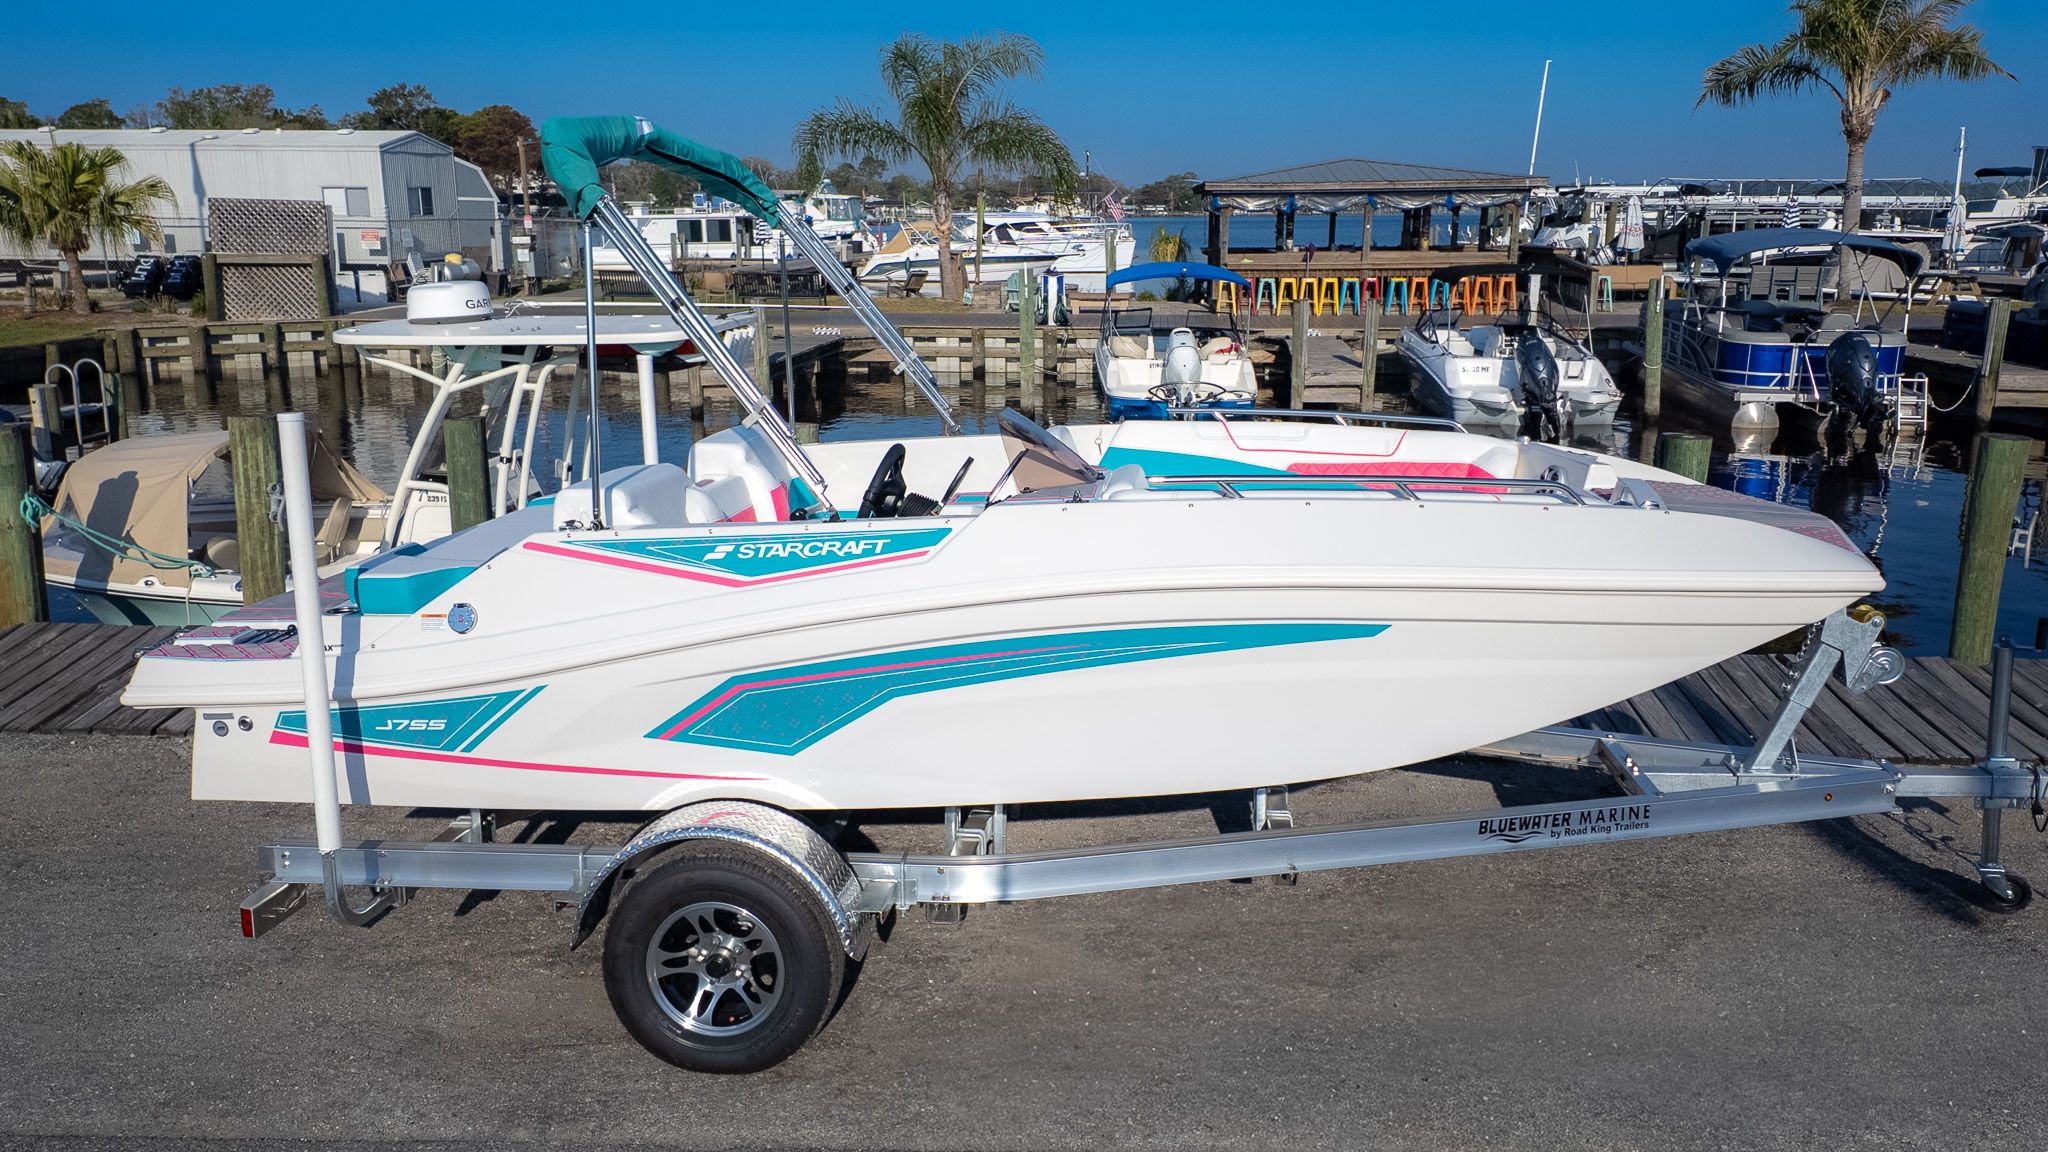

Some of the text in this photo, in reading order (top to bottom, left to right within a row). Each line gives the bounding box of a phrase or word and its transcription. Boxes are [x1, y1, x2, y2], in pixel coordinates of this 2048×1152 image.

[465, 298, 489, 309] GAR
[736, 538, 892, 559] STARCRAFT
[1478, 804, 1651, 835] BLUEWATER MARINE
[1550, 820, 1650, 840] by Road King Trailers
